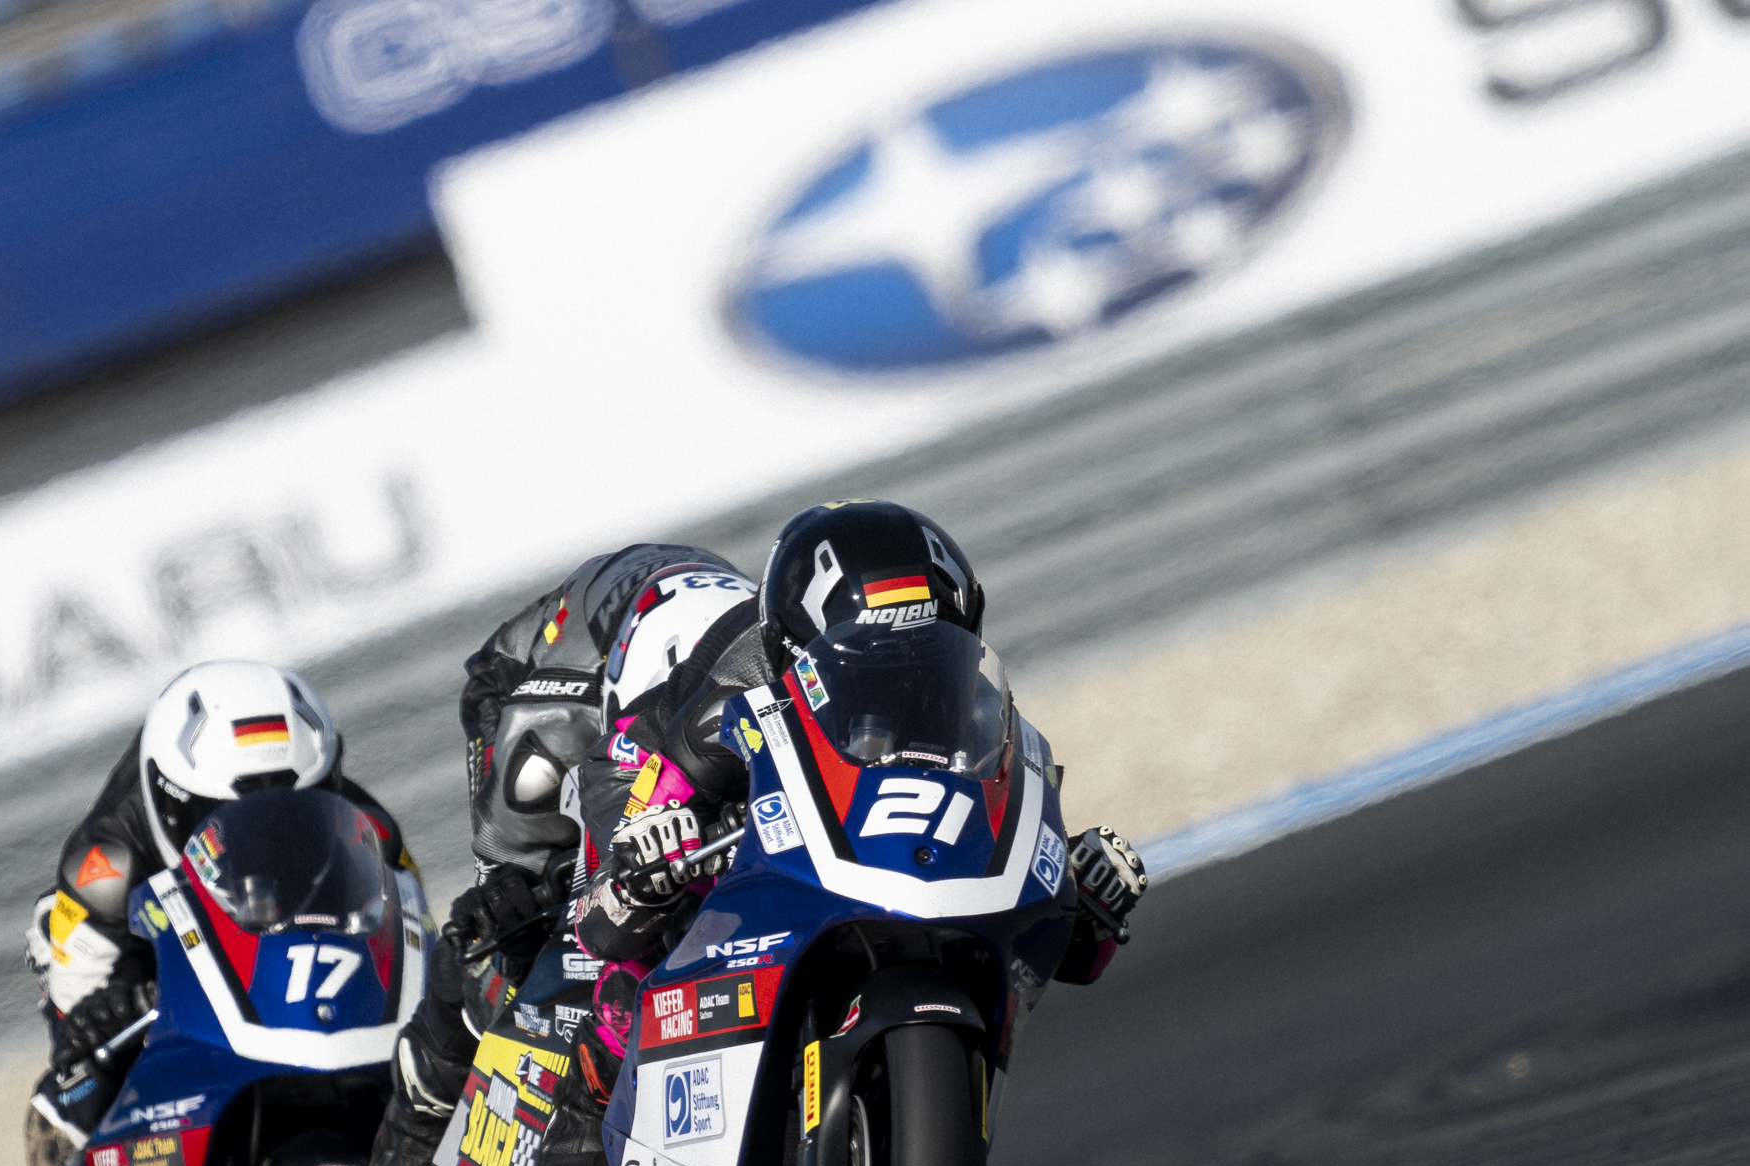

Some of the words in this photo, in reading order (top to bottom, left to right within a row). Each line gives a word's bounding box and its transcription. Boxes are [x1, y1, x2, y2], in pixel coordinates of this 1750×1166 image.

[855, 599, 939, 632] NOLAN
[902, 752, 947, 763] HONDA
[859, 777, 974, 846] 21
[762, 825, 773, 844] Sport
[771, 822, 786, 848] Stiftung
[782, 820, 796, 837] ADAC
[706, 931, 792, 959] NSF
[726, 954, 773, 969] 250R
[285, 944, 363, 1004] 17
[738, 983, 752, 995] ADAC
[652, 988, 684, 1018] KIEFER
[699, 996, 715, 1009] ADAC
[715, 994, 730, 1007] Team
[916, 1005, 959, 1013] HONDA
[660, 1009, 693, 1040] RACING
[692, 1067, 709, 1087] ADAC
[806, 1051, 815, 1123] PIRELLI
[130, 1093, 207, 1125] NSF
[485, 1073, 519, 1125] JUNIOR
[693, 1093, 720, 1111] Stiftung
[693, 1115, 712, 1134] Sport
